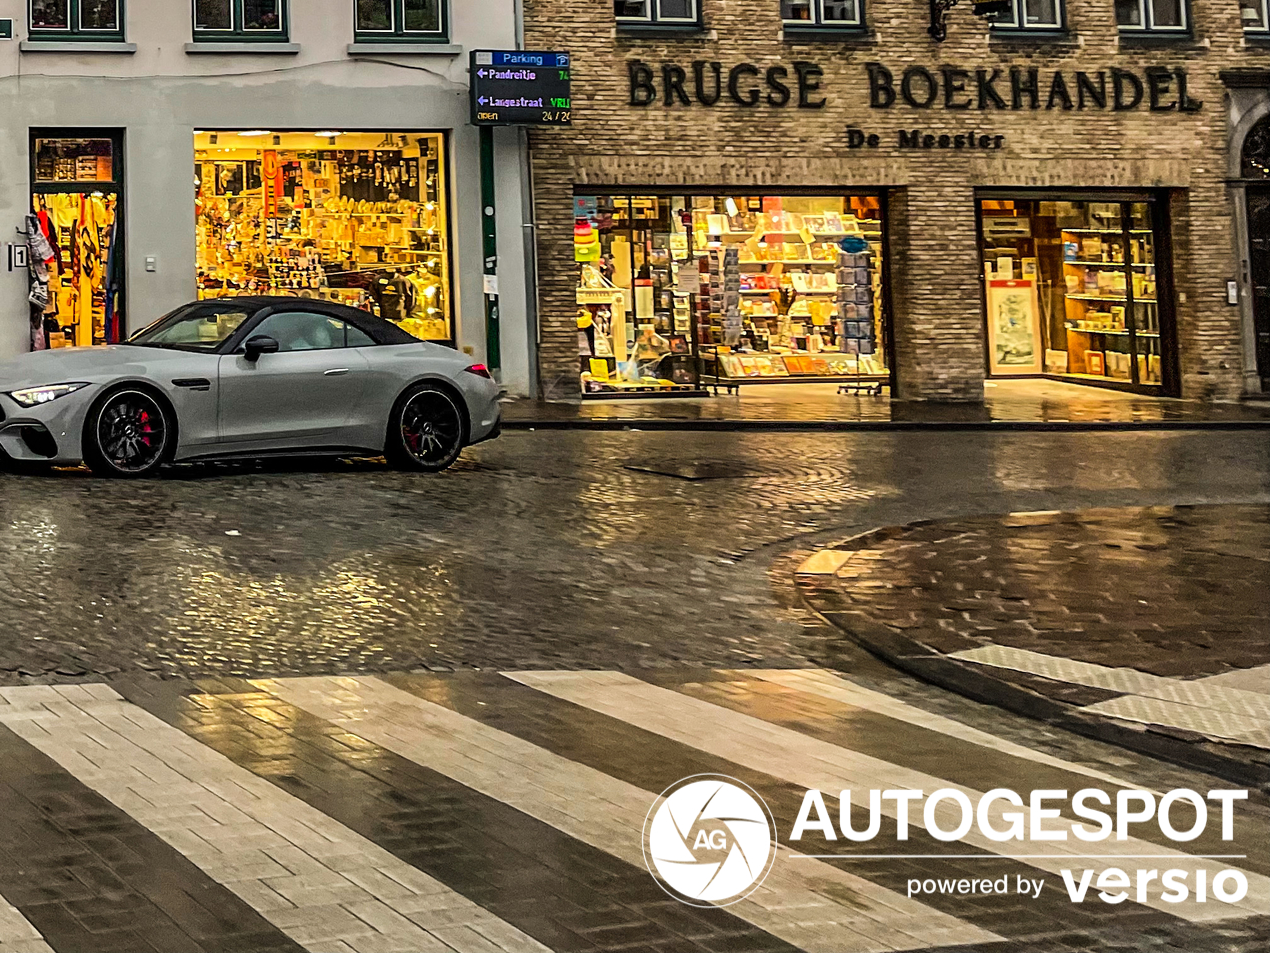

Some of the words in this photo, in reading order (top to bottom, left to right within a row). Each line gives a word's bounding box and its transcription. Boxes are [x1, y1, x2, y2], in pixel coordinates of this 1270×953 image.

[503, 53, 543, 66] Parking
[489, 69, 536, 81] Pandreitje
[627, 59, 827, 109] BRUGSE
[865, 61, 1203, 112] BOEKHANDEL
[489, 96, 543, 108] Langestraat
[846, 125, 880, 149] De
[898, 129, 1005, 149] Meester
